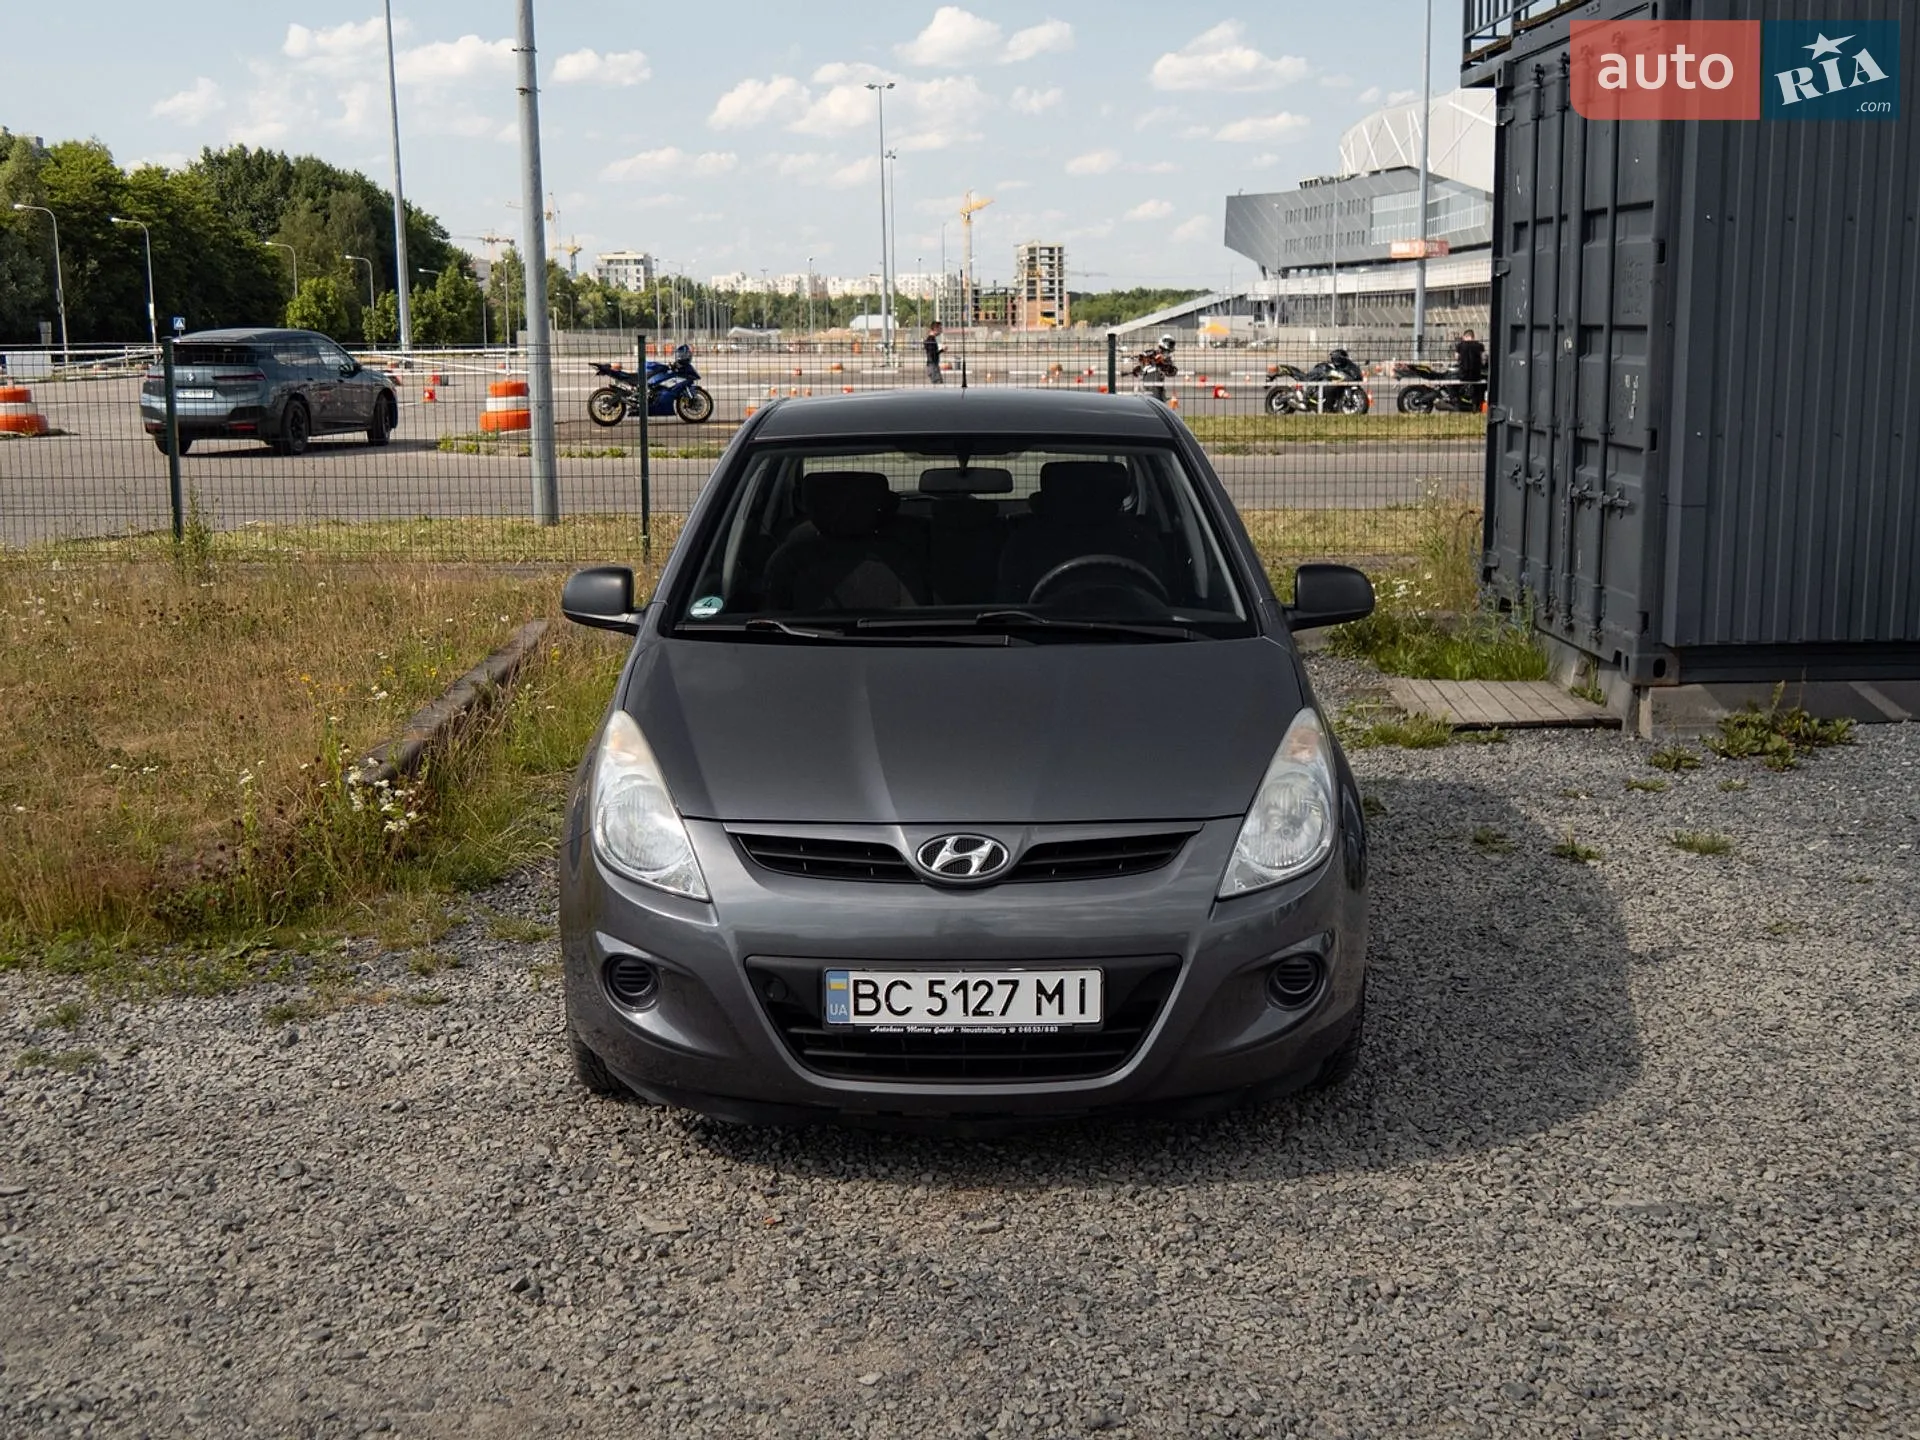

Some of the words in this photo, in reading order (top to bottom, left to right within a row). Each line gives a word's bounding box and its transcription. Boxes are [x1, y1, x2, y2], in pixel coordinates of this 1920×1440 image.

[829, 1003, 848, 1016] UA
[852, 979, 913, 1016] BC
[926, 979, 1020, 1017] 5127
[1035, 978, 1086, 1016] MI
